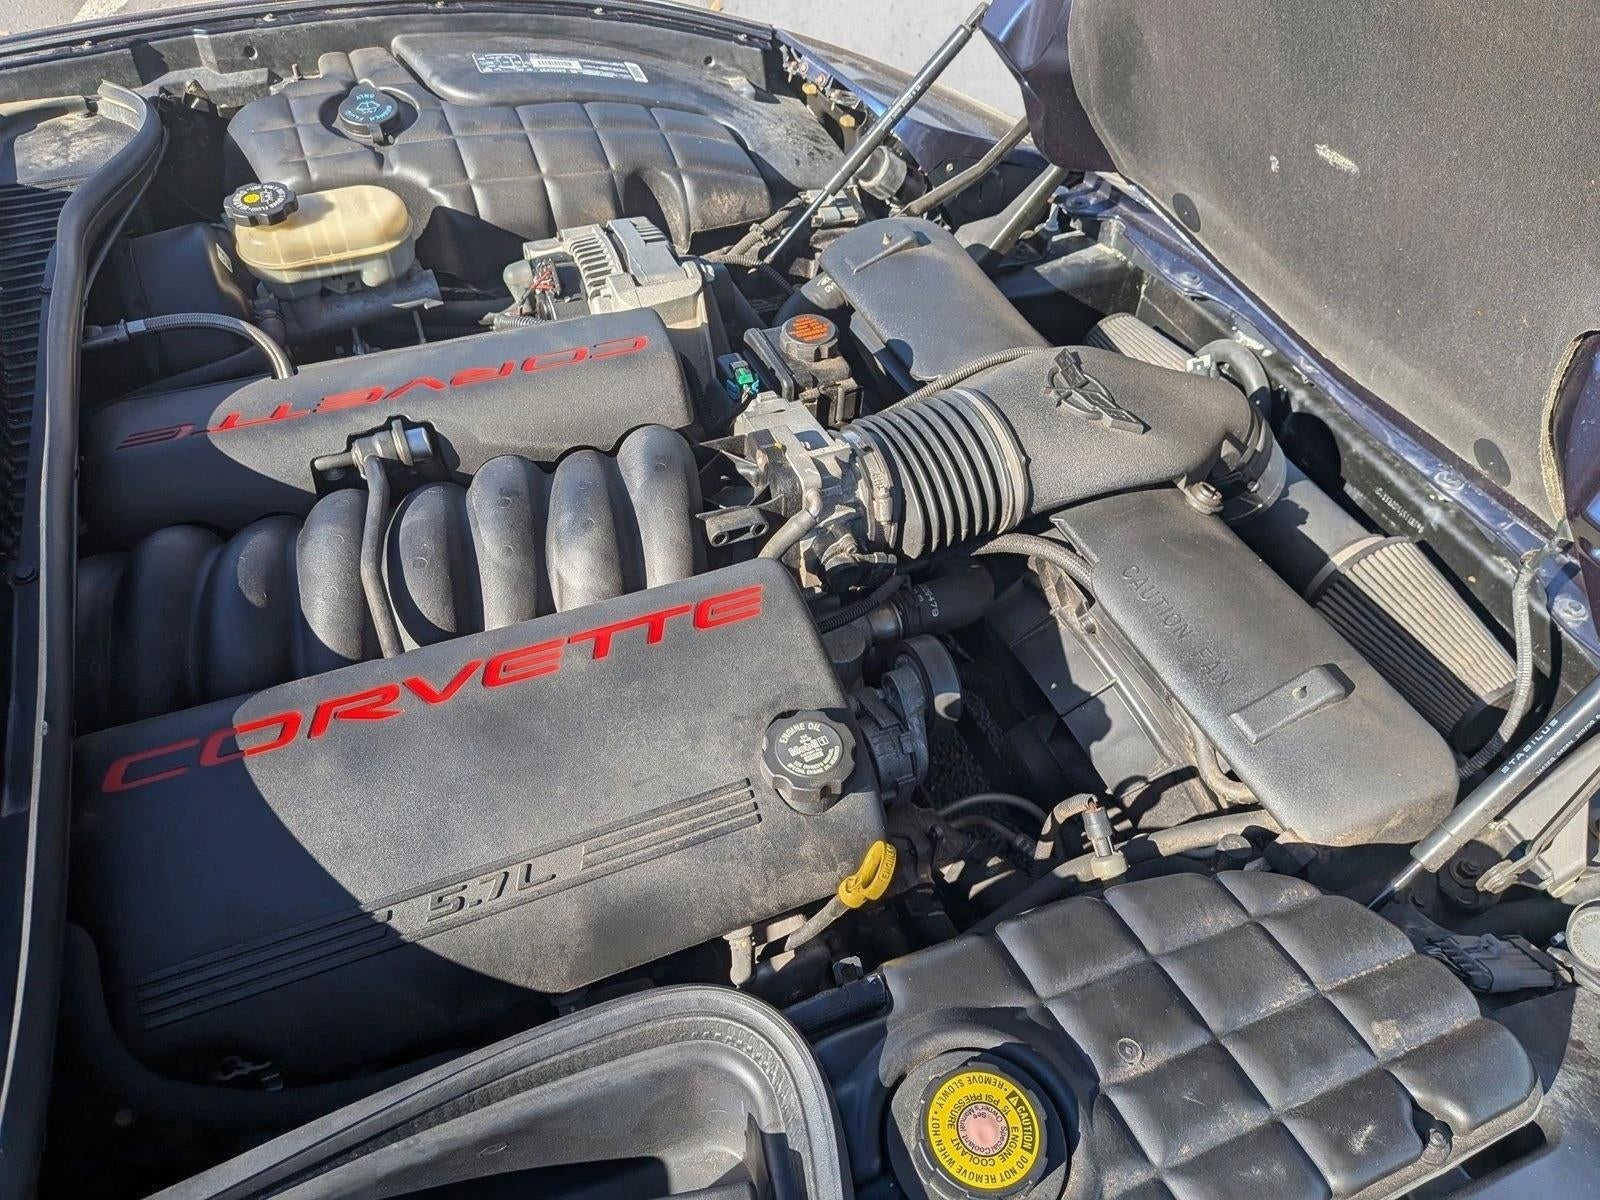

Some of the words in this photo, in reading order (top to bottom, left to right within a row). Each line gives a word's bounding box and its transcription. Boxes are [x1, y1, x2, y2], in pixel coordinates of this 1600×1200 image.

[116, 336, 647, 450] CORVETTE
[1122, 566, 1193, 638] CAUTION
[1199, 646, 1236, 686] FAN
[101, 584, 763, 793] CORVETTE
[779, 722, 805, 744] ENGINE
[808, 722, 820, 732] OIL
[1501, 718, 1558, 774] STABILUS
[427, 862, 558, 924] 5.7L
[939, 1078, 965, 1109] SLOWLY
[967, 1075, 1005, 1090] REMOVE
[947, 1093, 983, 1130] PRESSURE
[974, 1105, 1003, 1123] Owner's
[985, 1093, 1001, 1106] PSI
[1001, 1105, 1012, 1116] 15
[931, 1116, 941, 1137] HOT
[958, 1106, 975, 1135] Manual
[972, 1110, 987, 1120] See
[1018, 1106, 1033, 1150] CAUTION
[935, 1139, 957, 1167] WHEN
[950, 1137, 996, 1167] COOLANT
[991, 1125, 1008, 1154] Special
[1000, 1126, 1019, 1163] ENGINE
[956, 1165, 997, 1184] REMOVE
[999, 1168, 1018, 1183] NOT
[1016, 1155, 1029, 1170] DO
